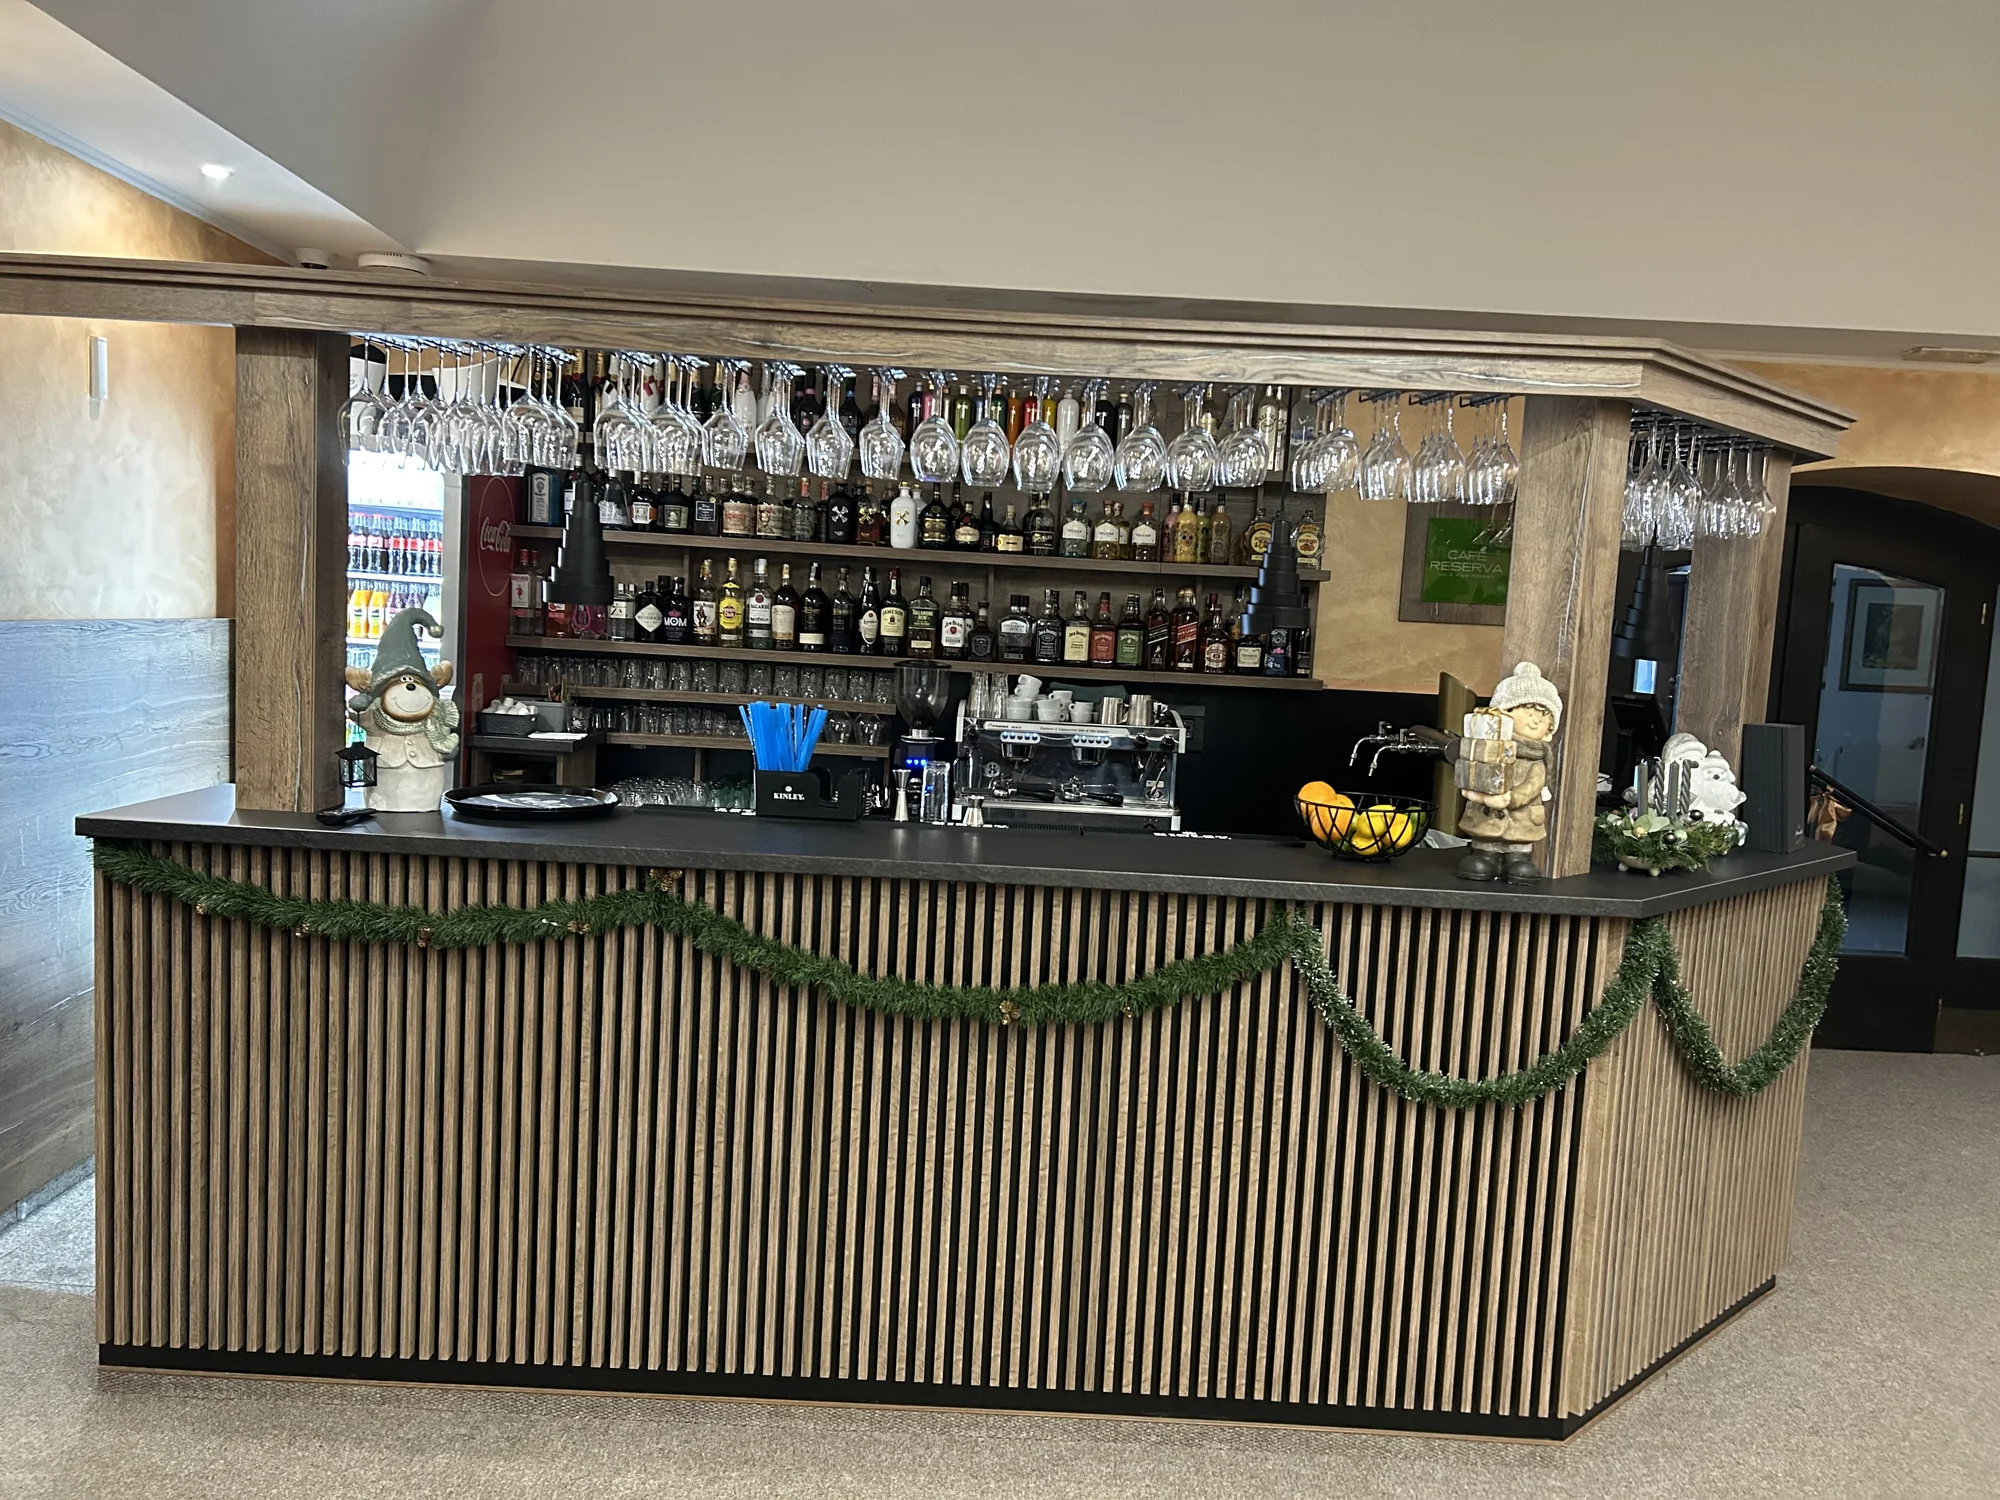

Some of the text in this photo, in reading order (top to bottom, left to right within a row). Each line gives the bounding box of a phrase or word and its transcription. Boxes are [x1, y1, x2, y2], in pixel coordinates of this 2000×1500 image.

[359, 497, 384, 505] ICE
[1447, 546, 1488, 561] CAFÉ
[1429, 560, 1504, 574] RESERVA
[882, 608, 904, 616] JAMESON
[663, 616, 688, 628] MOM
[773, 792, 804, 801] KINLEY
